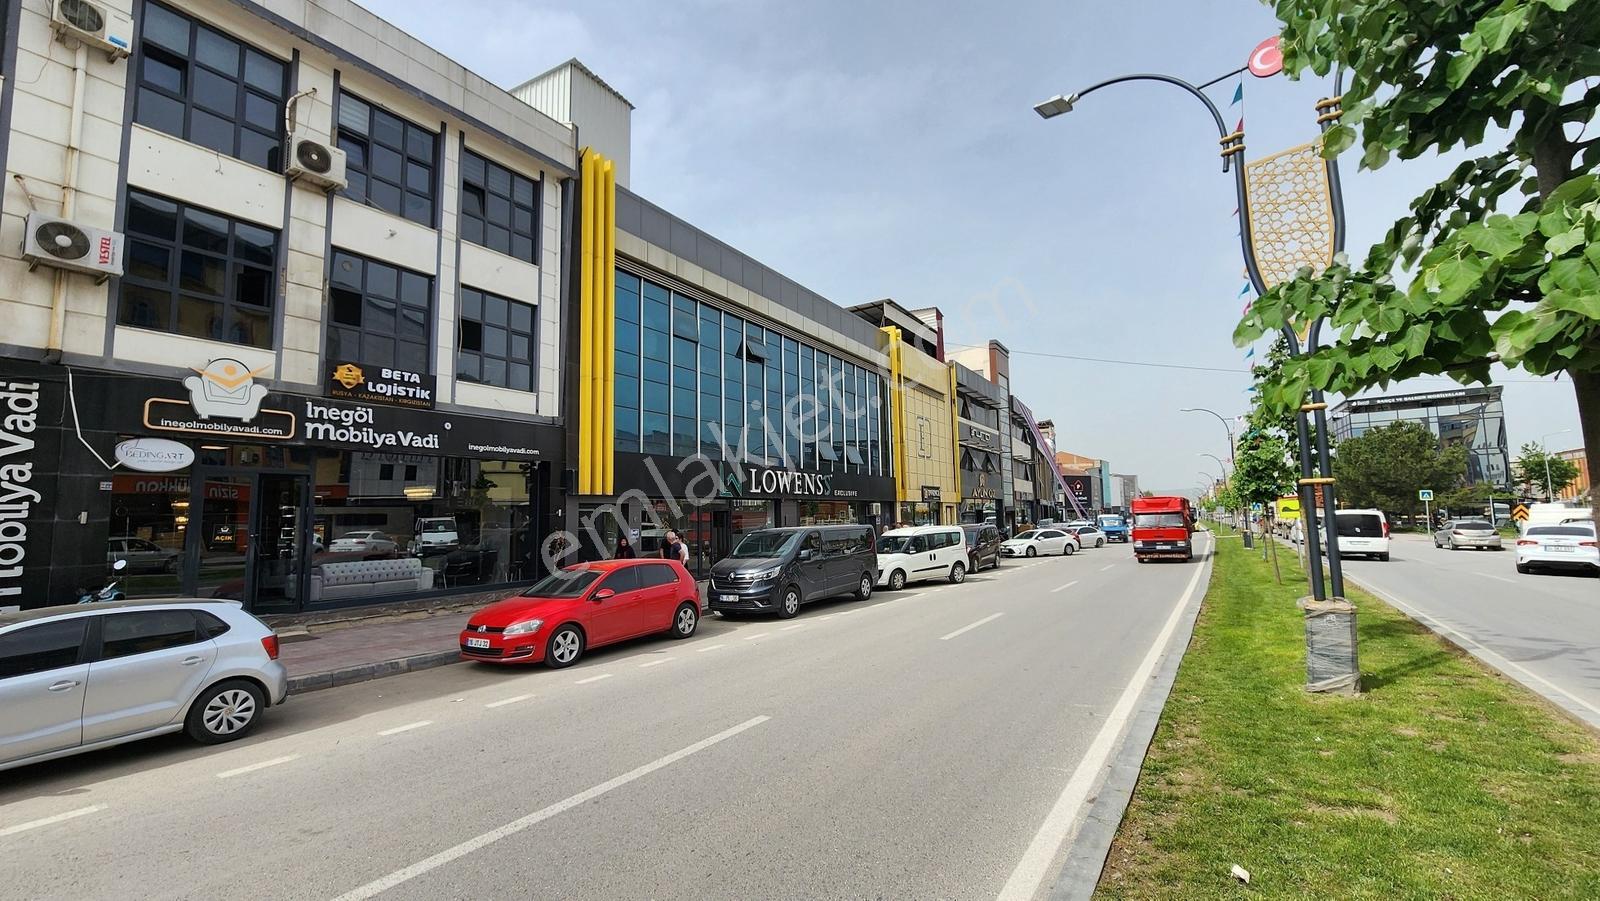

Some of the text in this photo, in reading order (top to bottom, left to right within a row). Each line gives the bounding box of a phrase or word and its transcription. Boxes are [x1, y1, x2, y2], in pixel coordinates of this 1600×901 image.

[99, 236, 111, 264] VESTEL
[381, 368, 421, 383] BETA
[332, 388, 353, 398] RUSYA
[161, 418, 283, 436] inegolmobilyavadi.com
[397, 429, 440, 449] Vadi
[468, 443, 540, 456] inegolmobilyavadi.com
[833, 489, 858, 497] EXCLUSIVE
[215, 535, 233, 543] AÇIK
